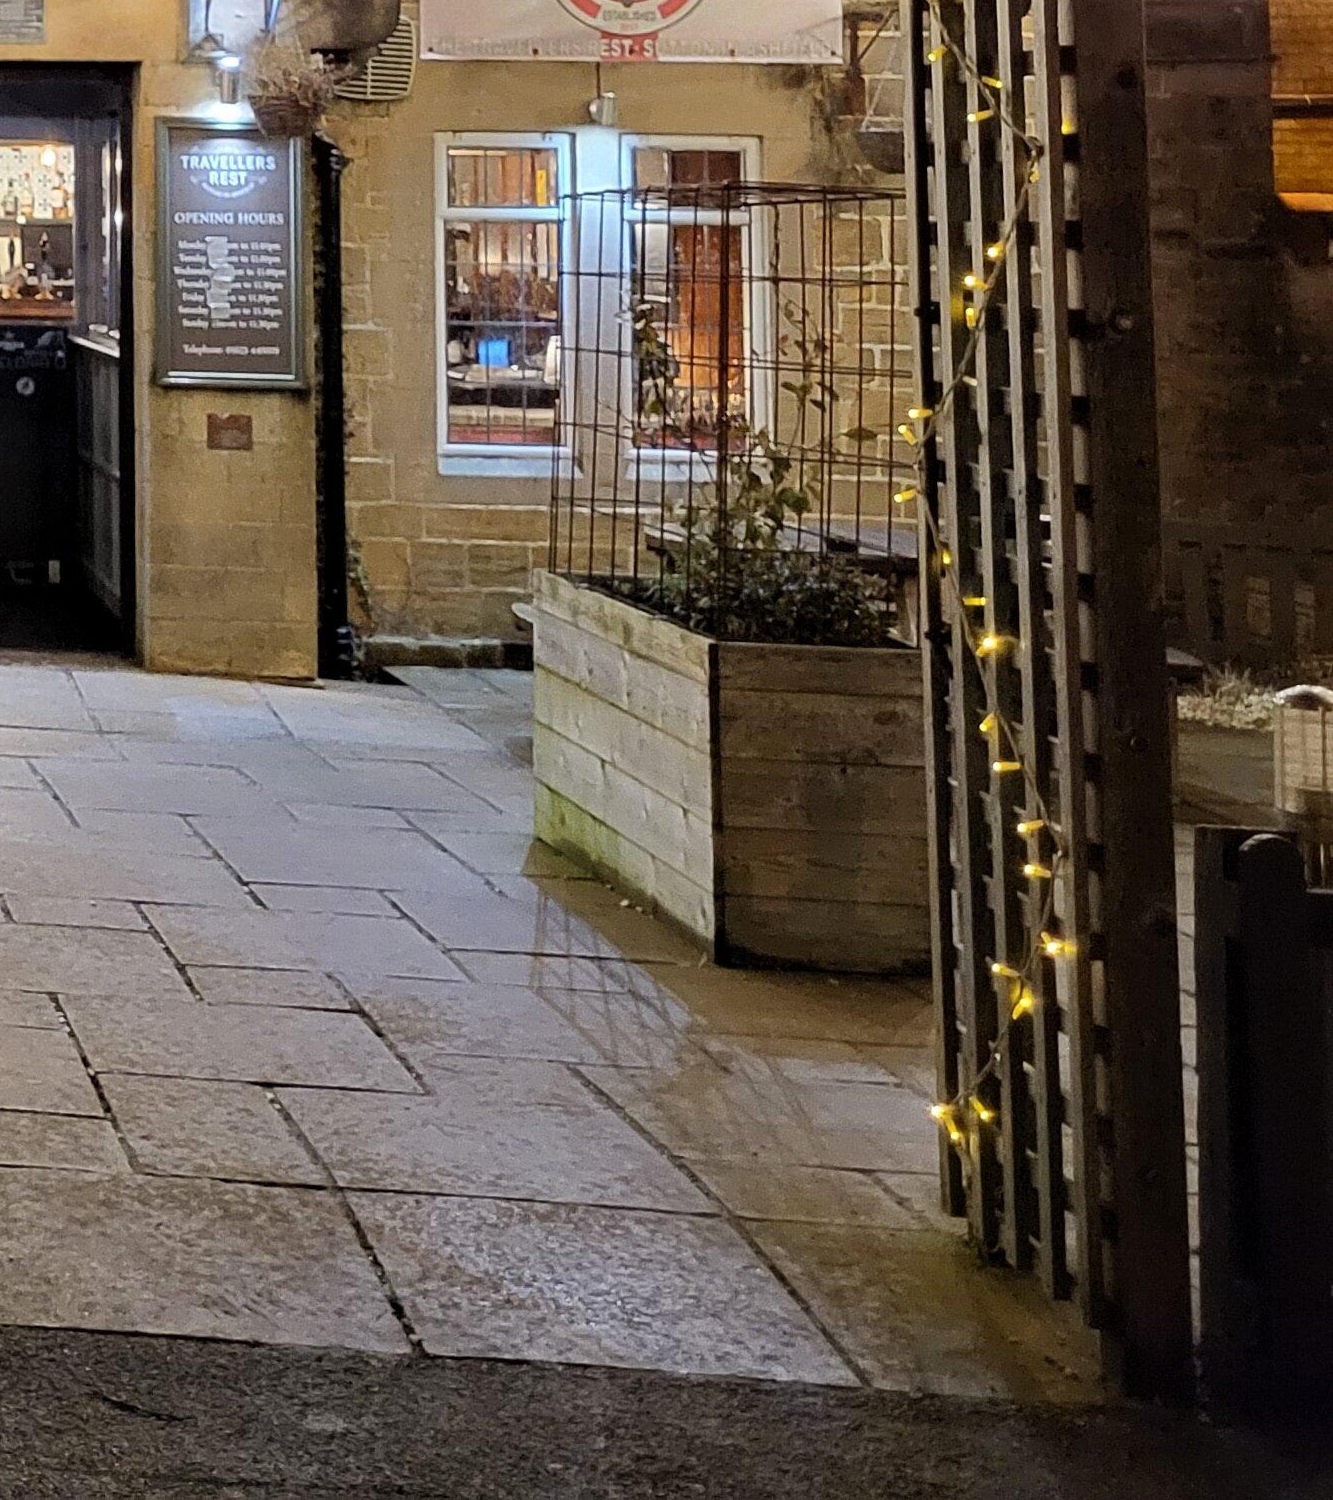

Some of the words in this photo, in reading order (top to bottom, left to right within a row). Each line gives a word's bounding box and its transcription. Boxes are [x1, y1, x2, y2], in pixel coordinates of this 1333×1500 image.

[180, 154, 277, 171] TRAVELLERS
[209, 170, 248, 186] REST
[173, 211, 234, 225] OPENING
[237, 211, 285, 226] HOURS
